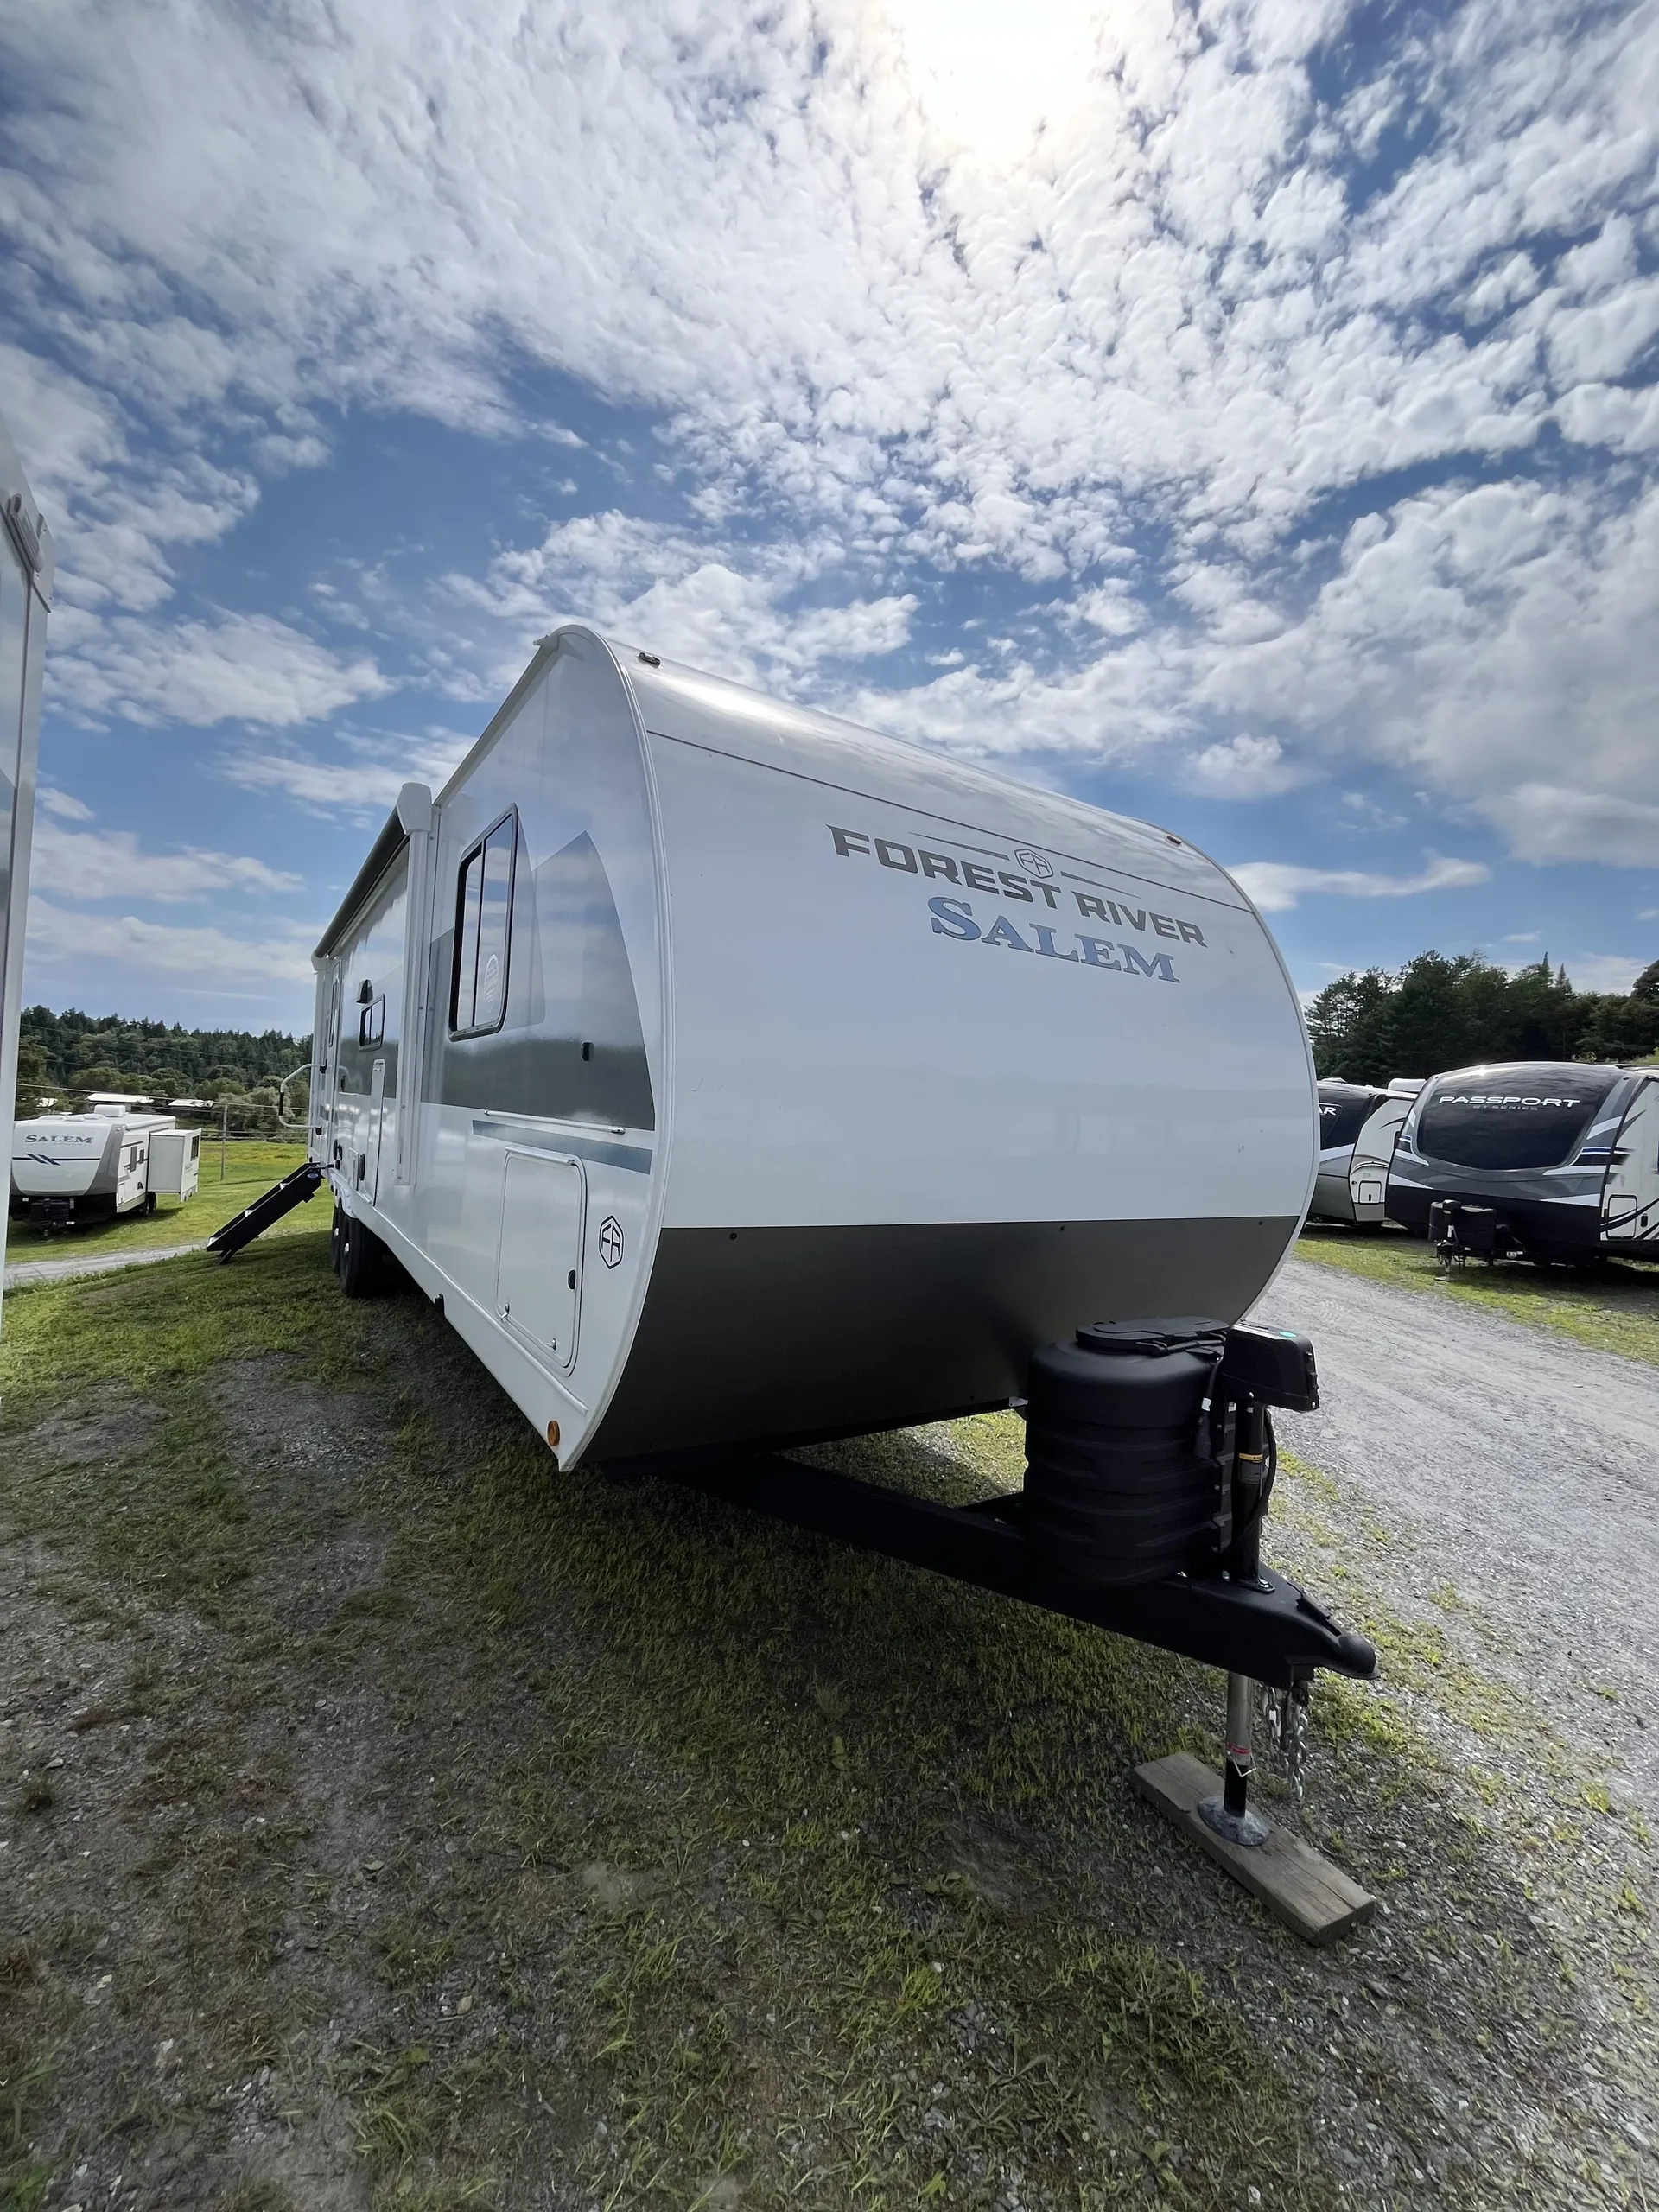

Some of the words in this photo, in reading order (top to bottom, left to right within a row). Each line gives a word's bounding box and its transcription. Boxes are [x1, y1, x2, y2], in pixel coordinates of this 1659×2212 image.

[826, 824, 1061, 910] FOREST
[1071, 889, 1209, 949] RIVER
[927, 895, 1182, 984] SALEM
[1438, 1096, 1581, 1109] PASSPORT
[24, 1134, 94, 1144] SALEM
